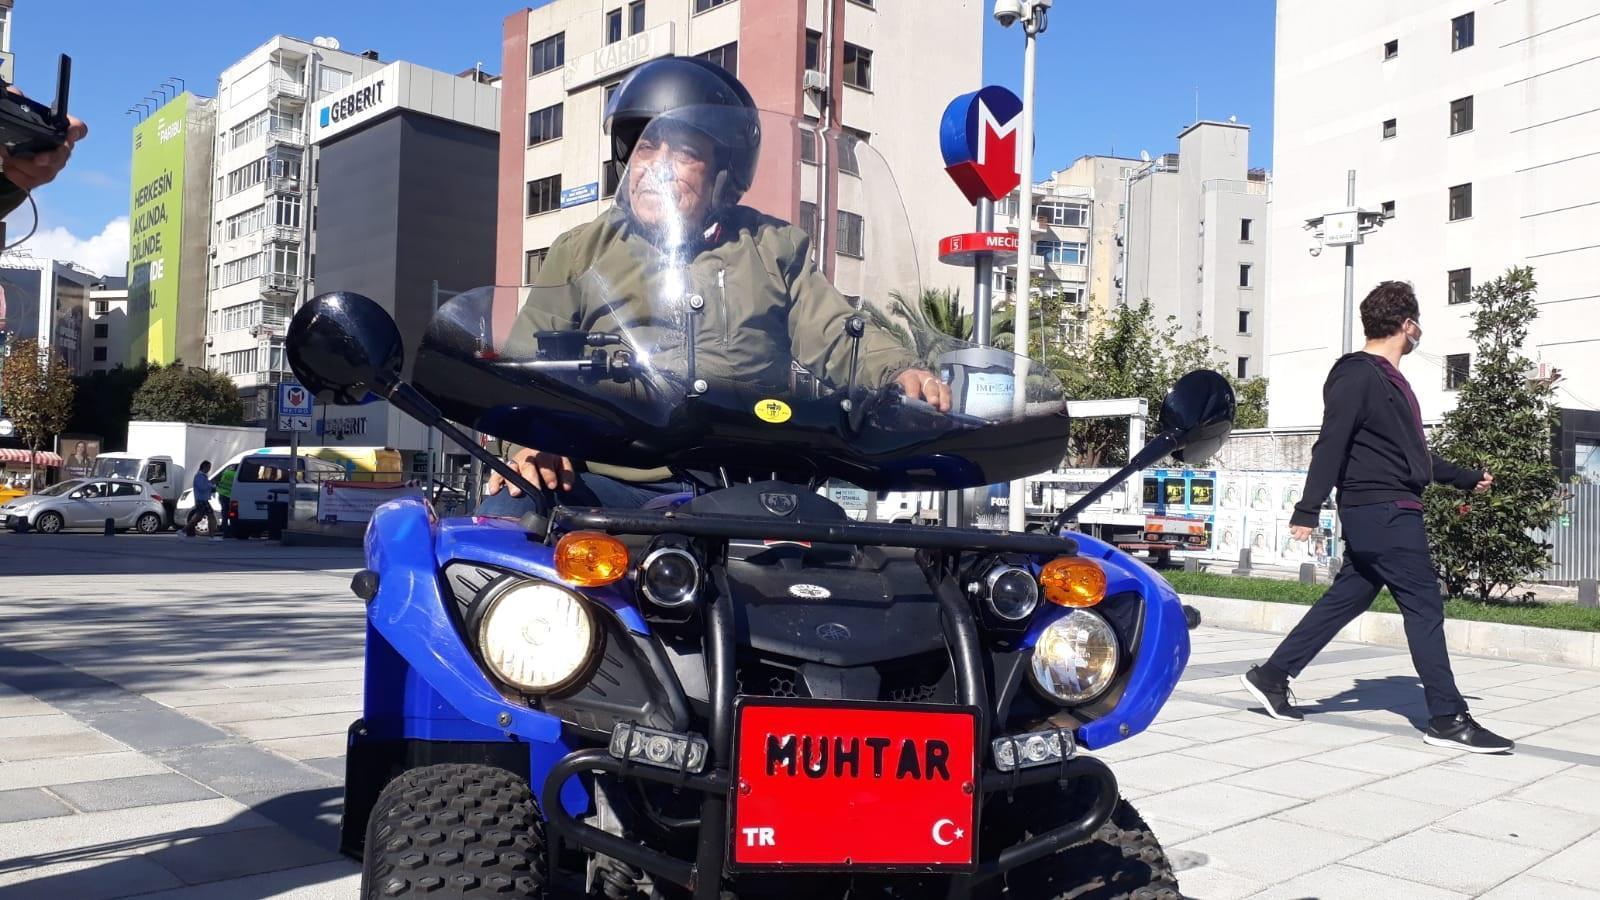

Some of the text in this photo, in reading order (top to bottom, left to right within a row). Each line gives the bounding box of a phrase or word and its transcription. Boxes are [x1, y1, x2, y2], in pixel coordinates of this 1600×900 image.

[331, 80, 385, 123] GEBERIT
[135, 168, 172, 209] HERKESİN
[766, 733, 950, 781] MUHTAR
[743, 827, 776, 847] TR
